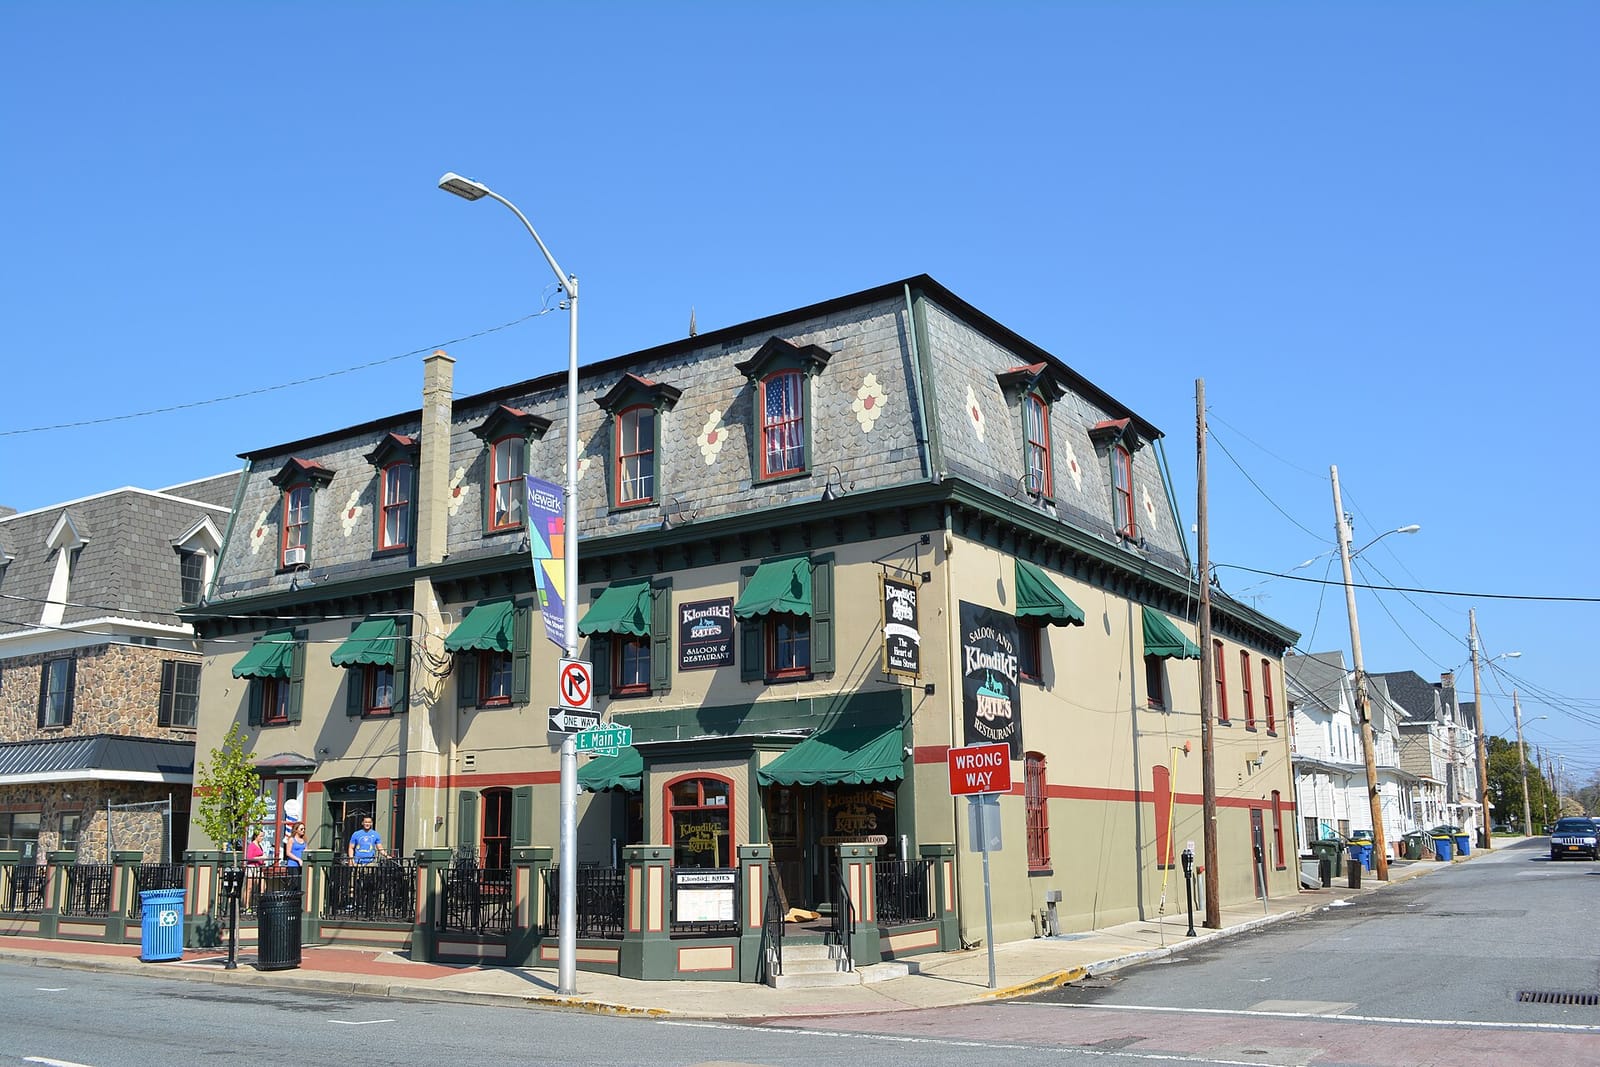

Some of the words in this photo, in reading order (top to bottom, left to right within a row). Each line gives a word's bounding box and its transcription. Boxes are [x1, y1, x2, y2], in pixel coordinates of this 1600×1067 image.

[527, 486, 562, 510] Newark
[969, 626, 996, 643] SALOON
[995, 632, 1013, 654] AND
[683, 652, 730, 663] RESTAURANT
[686, 645, 718, 655] SALOON
[890, 656, 902, 667] Main
[902, 658, 917, 670] Street
[976, 694, 1012, 721] KATE'S
[563, 716, 578, 727] ONE
[581, 718, 596, 728] WAY
[973, 717, 1015, 741] RESTAURANT
[580, 733, 588, 749] E.
[591, 731, 613, 747] Main
[617, 730, 626, 745] St
[956, 752, 1003, 770] WRONG
[966, 771, 993, 787] WAY
